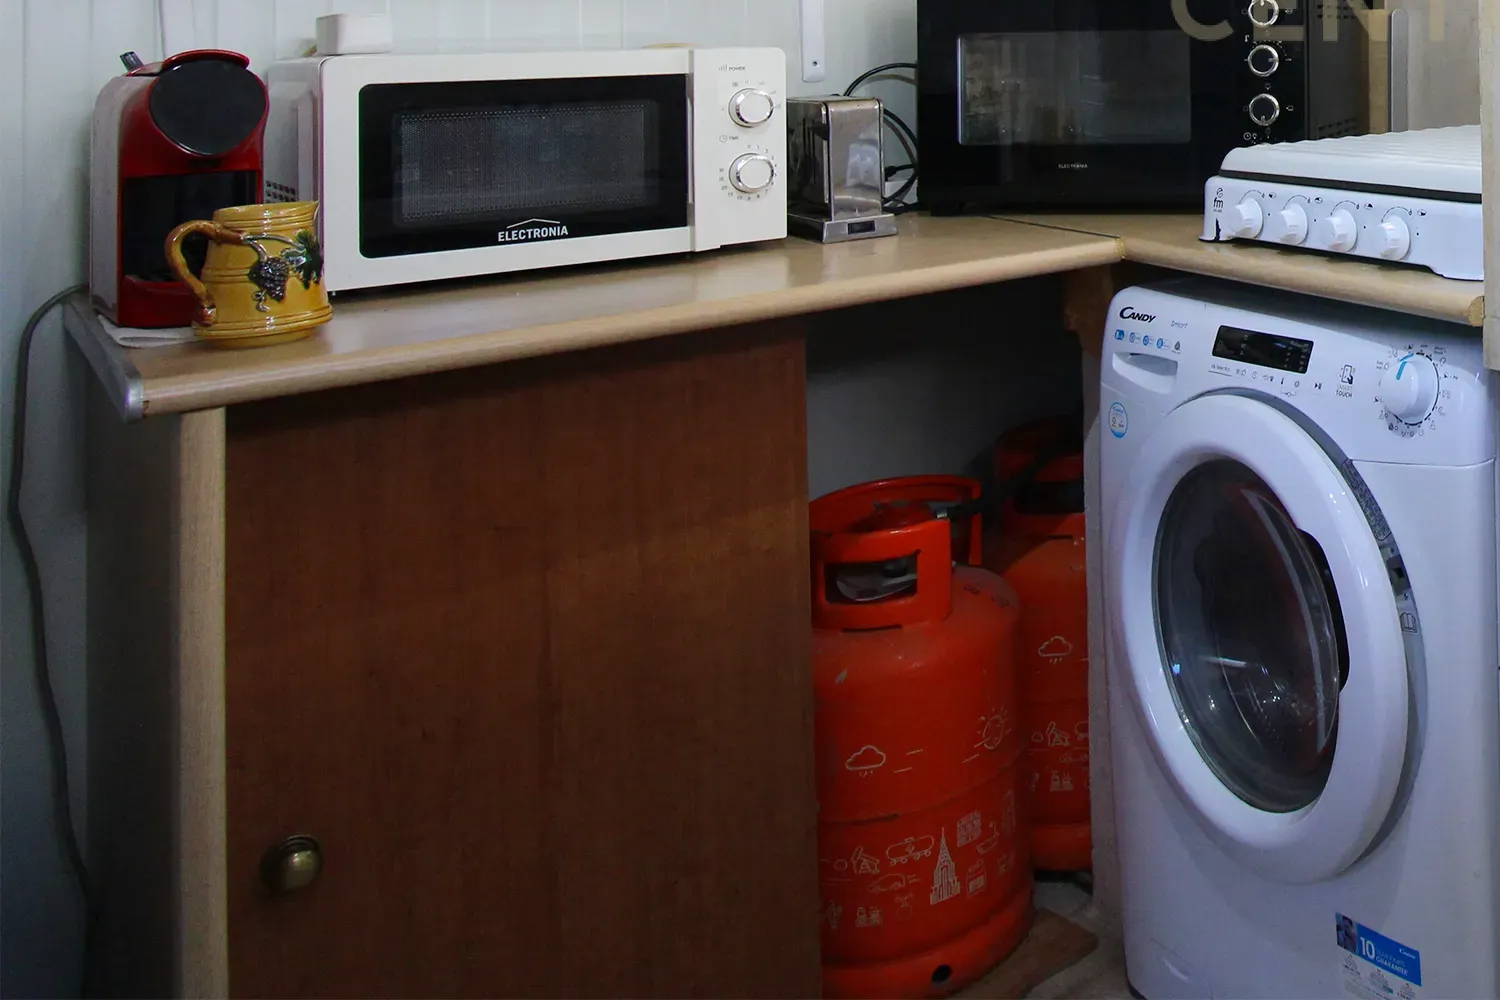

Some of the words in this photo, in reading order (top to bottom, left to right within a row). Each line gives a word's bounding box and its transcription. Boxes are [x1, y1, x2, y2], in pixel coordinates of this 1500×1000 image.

[1213, 197, 1224, 208] fm
[497, 225, 569, 242] ELECTRONIA
[1119, 306, 1157, 323] CANDY
[1171, 320, 1188, 329] Smart
[1335, 390, 1352, 398] TOUCH
[1360, 936, 1375, 960] 10
